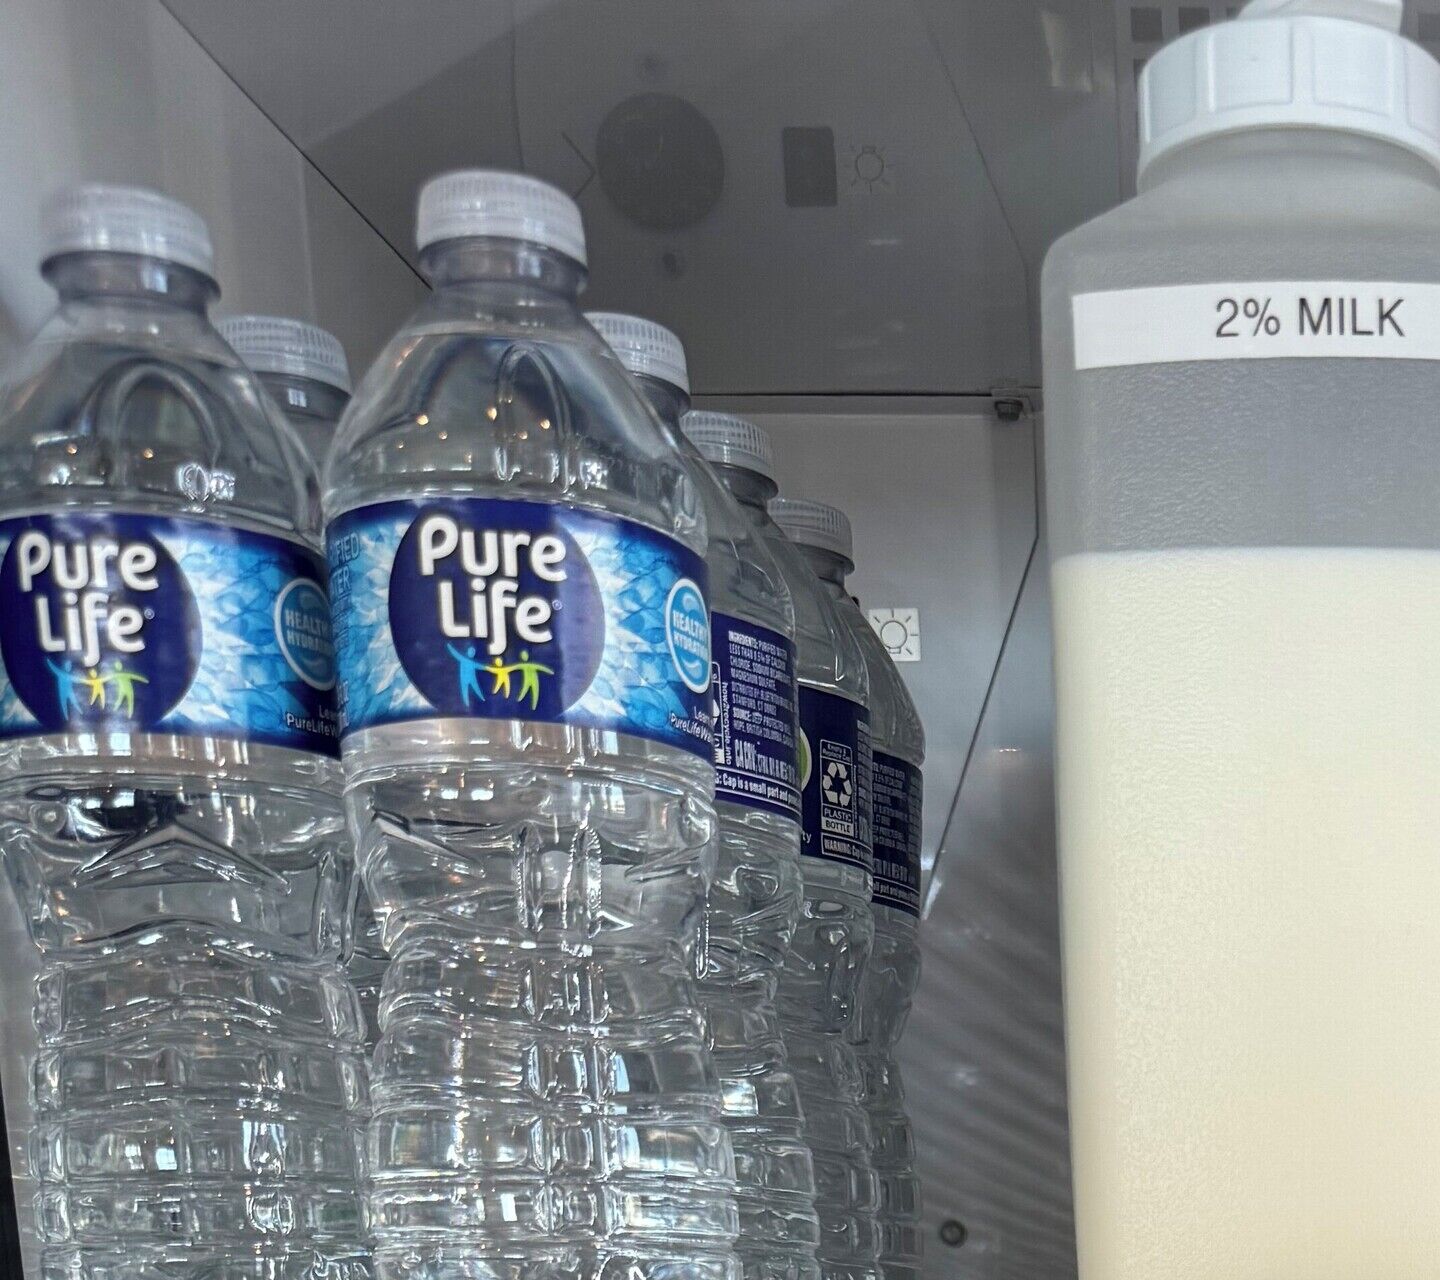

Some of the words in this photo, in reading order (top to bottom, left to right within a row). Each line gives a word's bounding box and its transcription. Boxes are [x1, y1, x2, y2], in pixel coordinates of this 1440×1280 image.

[1215, 298, 1281, 338] 2%
[1299, 297, 1405, 337] MILK
[17, 532, 159, 592] Pure
[420, 514, 568, 582] Pure
[36, 592, 145, 667] Life
[438, 579, 553, 655] Life
